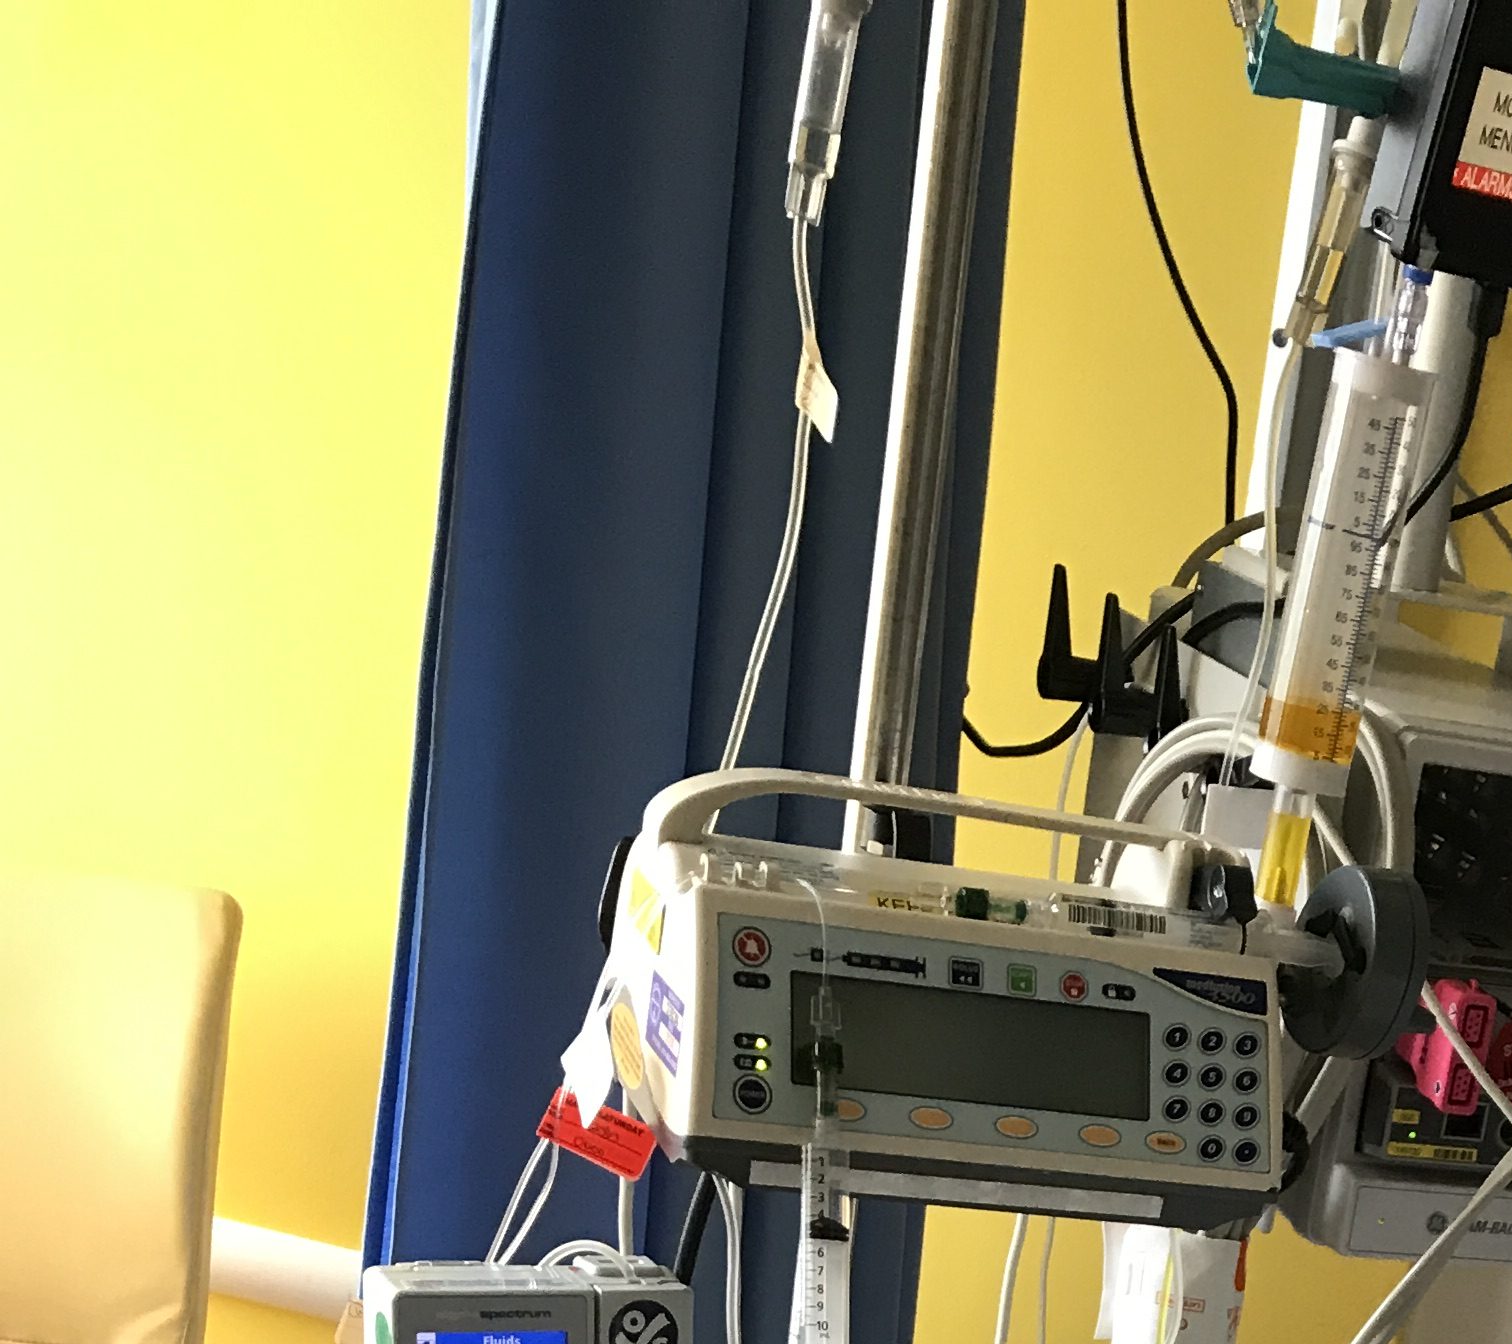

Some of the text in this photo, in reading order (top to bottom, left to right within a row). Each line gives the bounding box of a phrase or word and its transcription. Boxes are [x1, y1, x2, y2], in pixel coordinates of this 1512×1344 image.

[1174, 1032, 1181, 1042] 1
[1209, 1035, 1217, 1046] 2
[1244, 1039, 1251, 1050] 3
[1173, 1068, 1181, 1079] 4
[1209, 1071, 1216, 1082] 5
[1243, 1075, 1250, 1086] 6
[1173, 1104, 1181, 1114] 7
[1208, 1107, 1216, 1118] 8
[1243, 1111, 1250, 1122] 9
[1208, 1143, 1216, 1154] 0
[817, 1157, 825, 1167] 1
[817, 1175, 825, 1184] 2
[817, 1193, 825, 1202] 3
[817, 1248, 825, 1257] 6
[817, 1266, 824, 1275] 7
[817, 1284, 824, 1294] 8
[817, 1302, 824, 1311] 9
[480, 1309, 552, 1320] spectrum
[816, 1320, 829, 1331] 10
